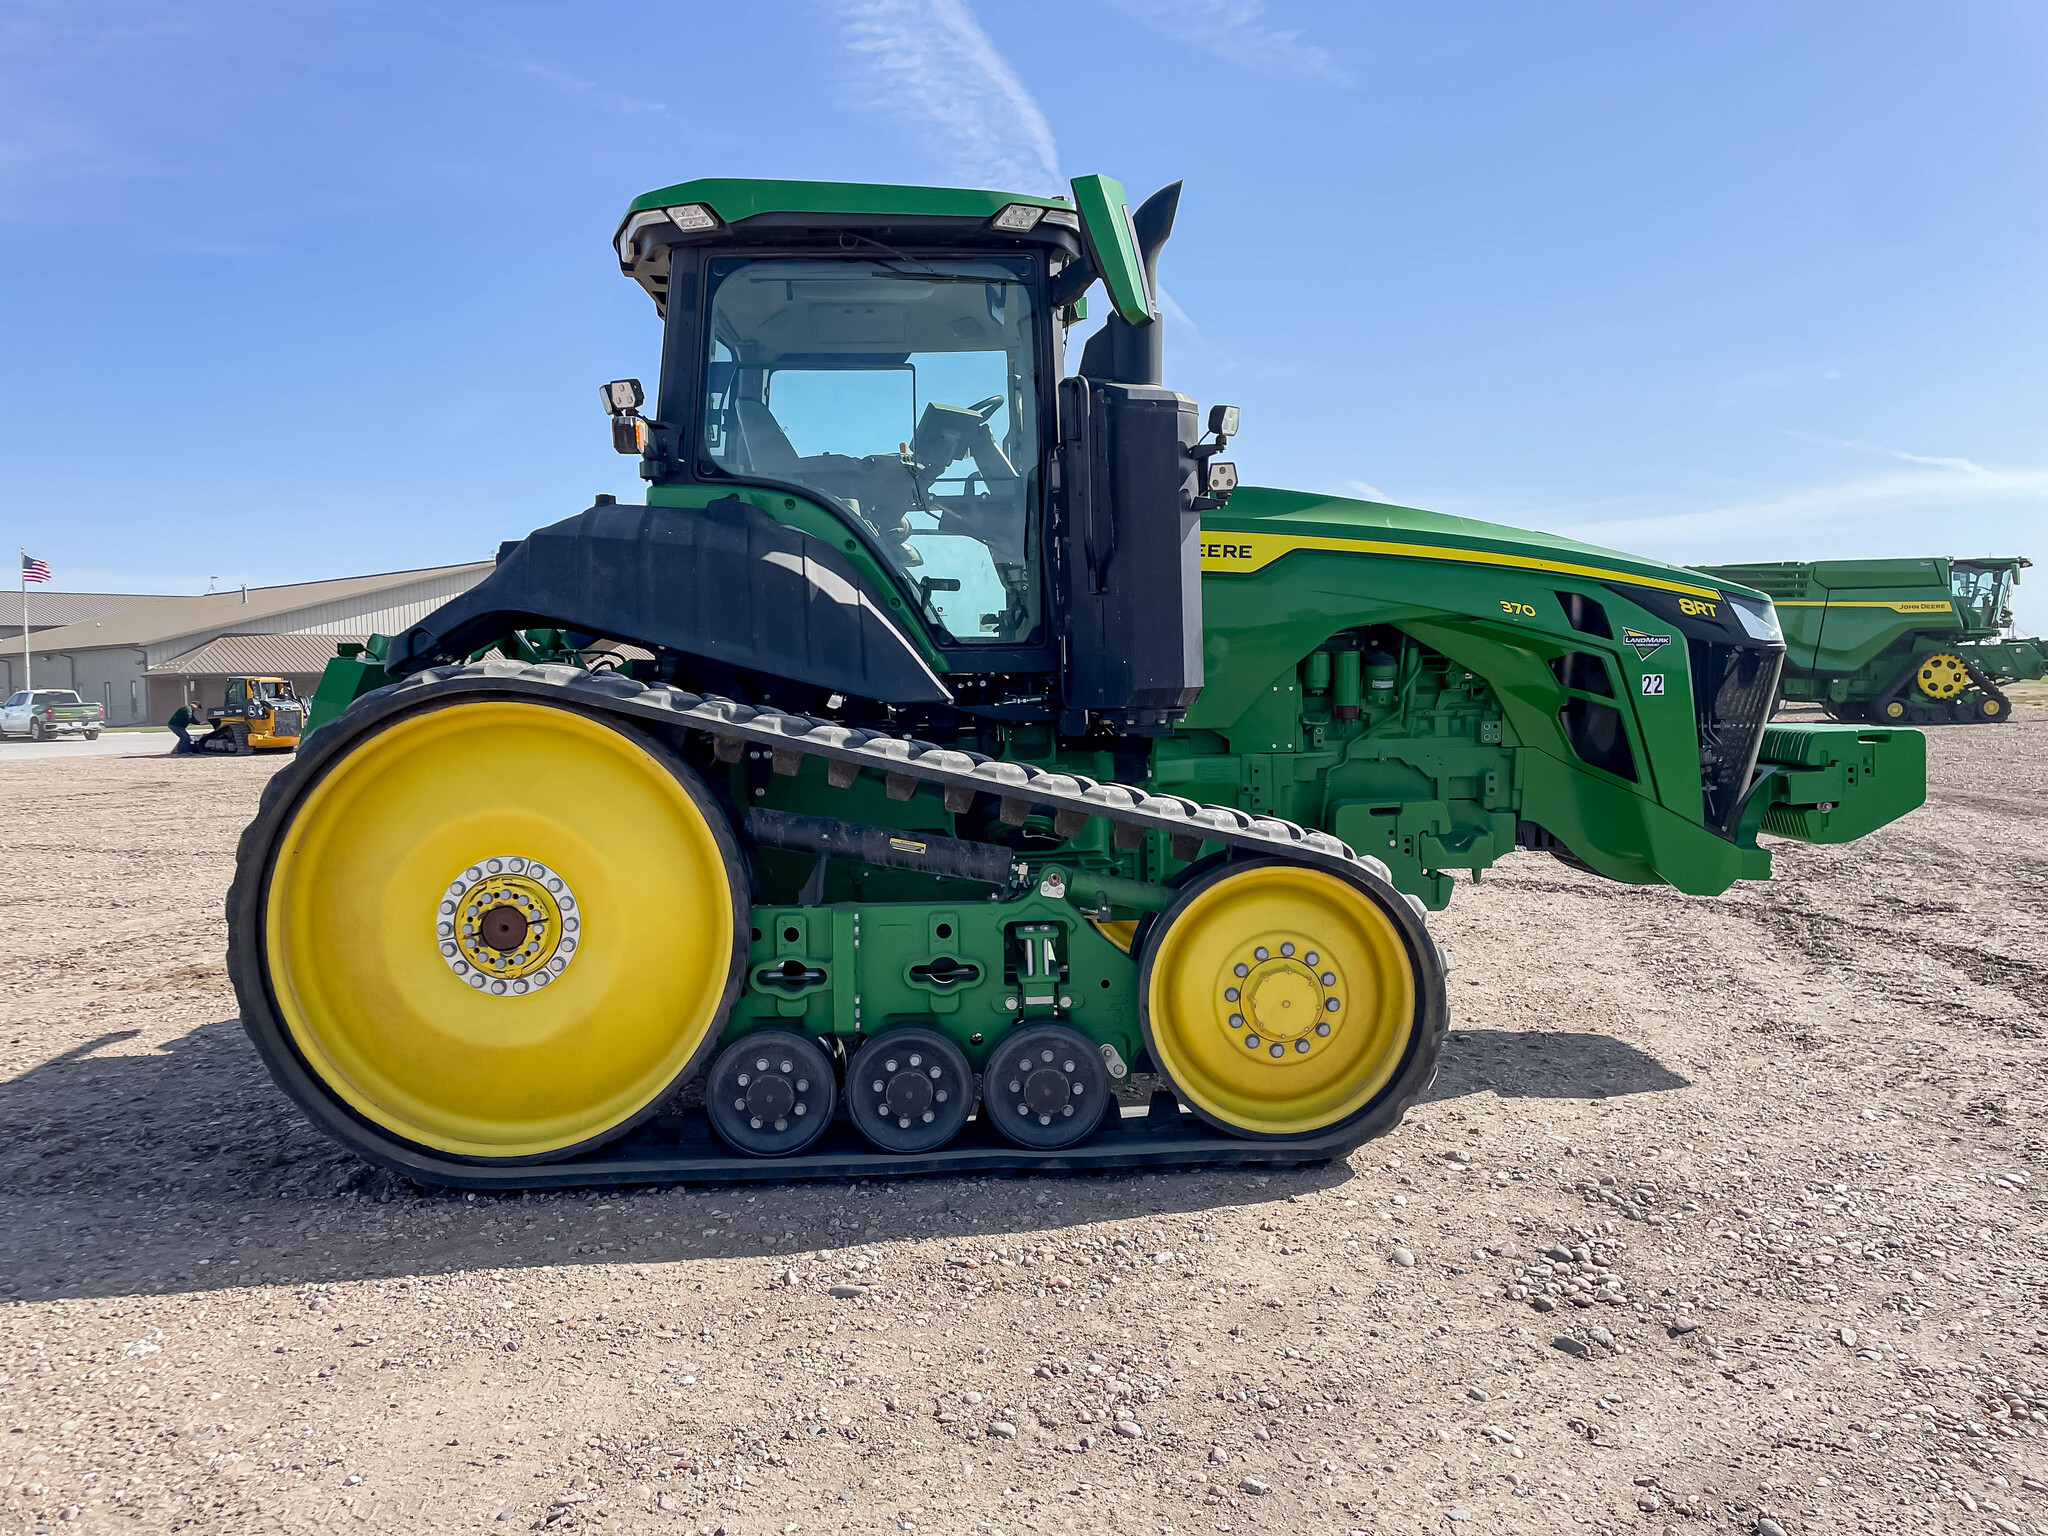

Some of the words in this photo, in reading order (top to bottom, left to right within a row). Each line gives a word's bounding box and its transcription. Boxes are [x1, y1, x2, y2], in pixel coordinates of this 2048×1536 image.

[1499, 600, 1537, 617] 370
[1678, 598, 1717, 617] 8RT
[1643, 675, 1663, 695] 22
